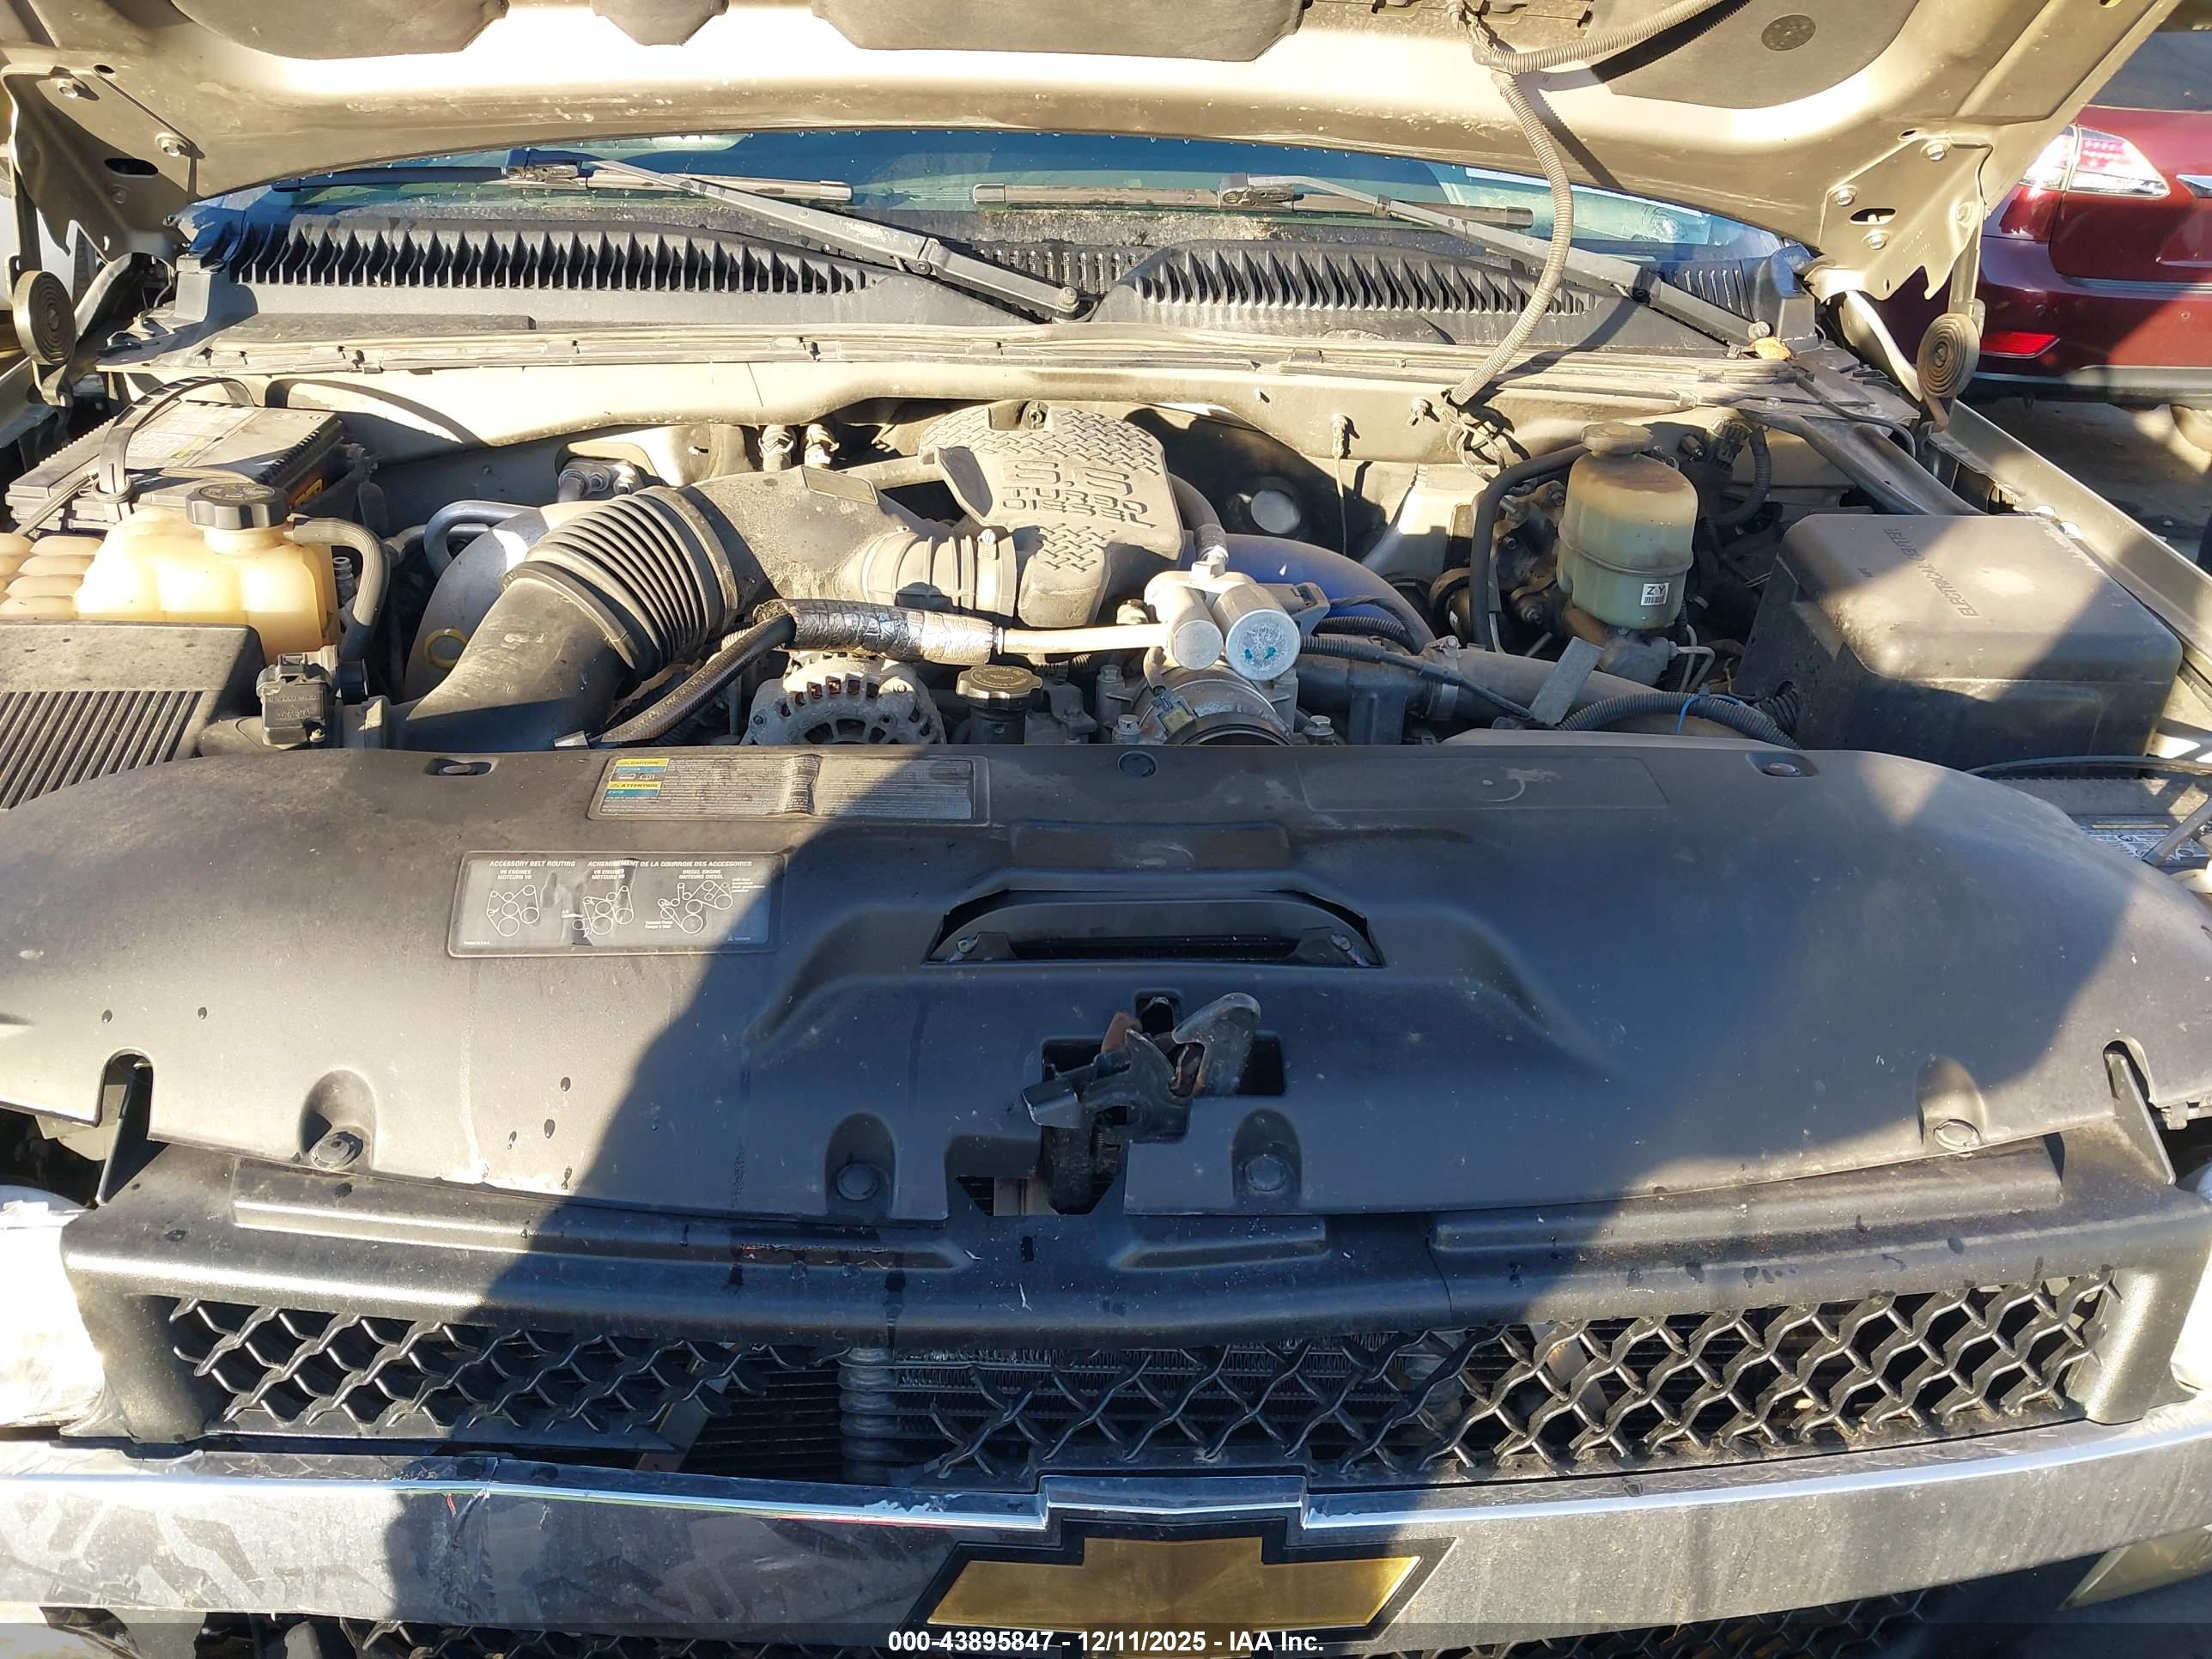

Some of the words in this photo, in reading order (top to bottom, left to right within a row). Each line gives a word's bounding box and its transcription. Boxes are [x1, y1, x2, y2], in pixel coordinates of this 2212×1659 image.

[1000, 498, 1158, 529] DIESEL
[1002, 487, 1148, 515] TURBO
[1917, 562, 1980, 617] ELECTRICAL
